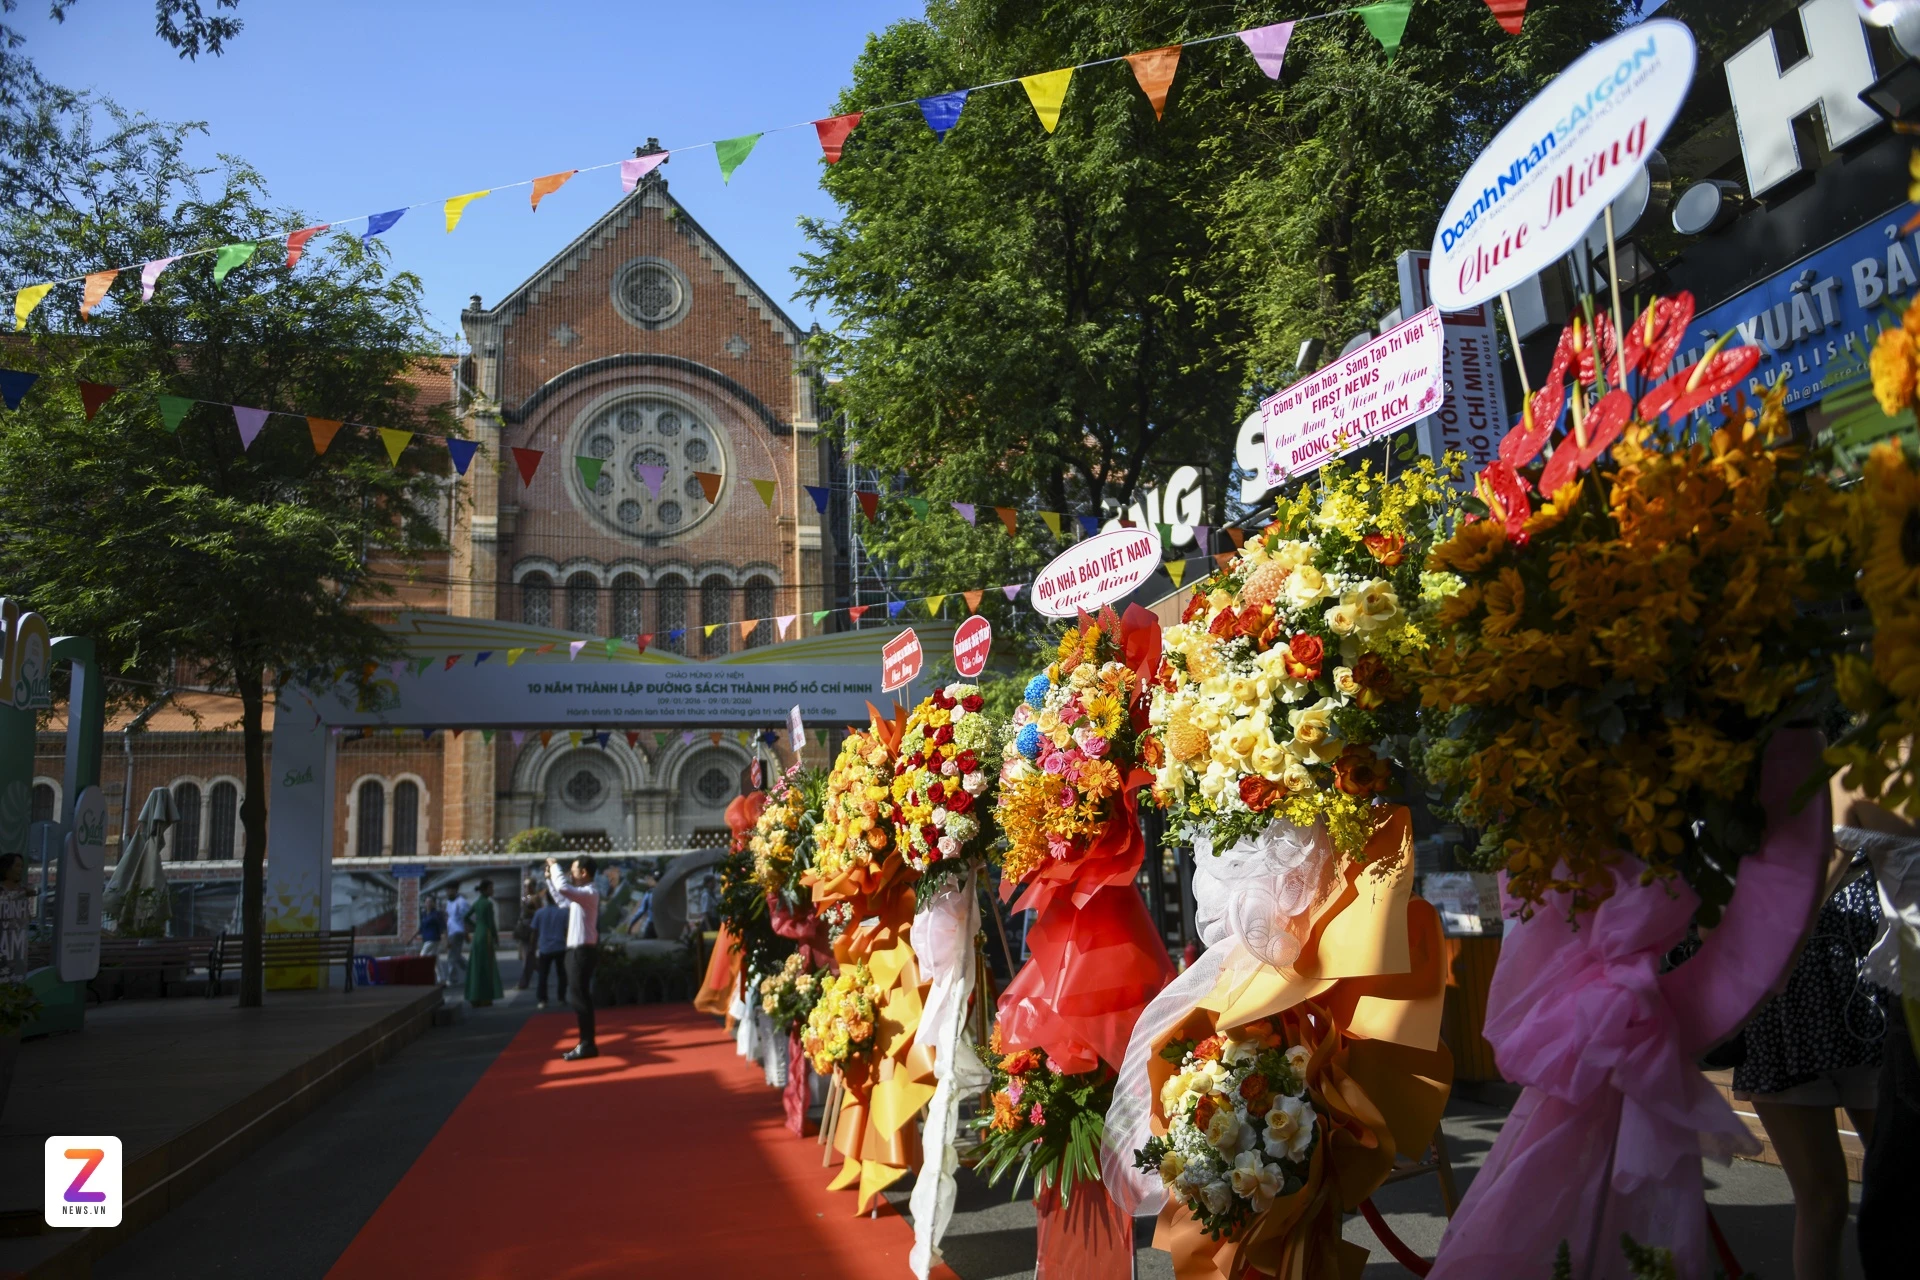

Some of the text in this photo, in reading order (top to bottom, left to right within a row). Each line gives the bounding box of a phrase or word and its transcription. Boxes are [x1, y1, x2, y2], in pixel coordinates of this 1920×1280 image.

[1459, 219, 1529, 296] Chúc
[1540, 116, 1648, 230] Mừng
[1736, 223, 1920, 355] XUẤT BẢ
[1273, 398, 1293, 416] Công
[1295, 392, 1302, 405] ty
[1304, 382, 1320, 399] Văn
[1321, 373, 1338, 390] hóa
[1345, 356, 1369, 377] Sáng
[1370, 345, 1387, 363] Tạo
[1389, 334, 1402, 353] Trí
[1404, 324, 1424, 343] Việt
[1459, 338, 1483, 391] MINH
[1481, 334, 1493, 367] HOUSE
[1275, 432, 1296, 450] Chúc
[1383, 380, 1395, 395] 10
[1312, 368, 1379, 414] FIRST NEWS
[1462, 394, 1487, 430] CHÍ
[1487, 373, 1500, 436] PUBLISHING
[1292, 394, 1409, 465] ĐƯỜNG SÁCH TP. HCM
[1038, 536, 1152, 601] HỘI NHÀ BÁO VIỆT NAM
[1055, 570, 1139, 610] Chúc Mừng
[527, 680, 872, 696] 10 NĂM THÀNH LẬP ĐƯỜNG SÁCH THÀNH PHỐ HỒ CHÍ MINH
[567, 708, 590, 716] Hành
[591, 708, 611, 716] trình
[613, 708, 623, 716] 10
[624, 708, 643, 716] năm
[644, 708, 658, 716] lan
[687, 708, 706, 716] thức
[708, 708, 718, 716] và
[720, 708, 743, 718] những
[744, 708, 761, 718] giá
